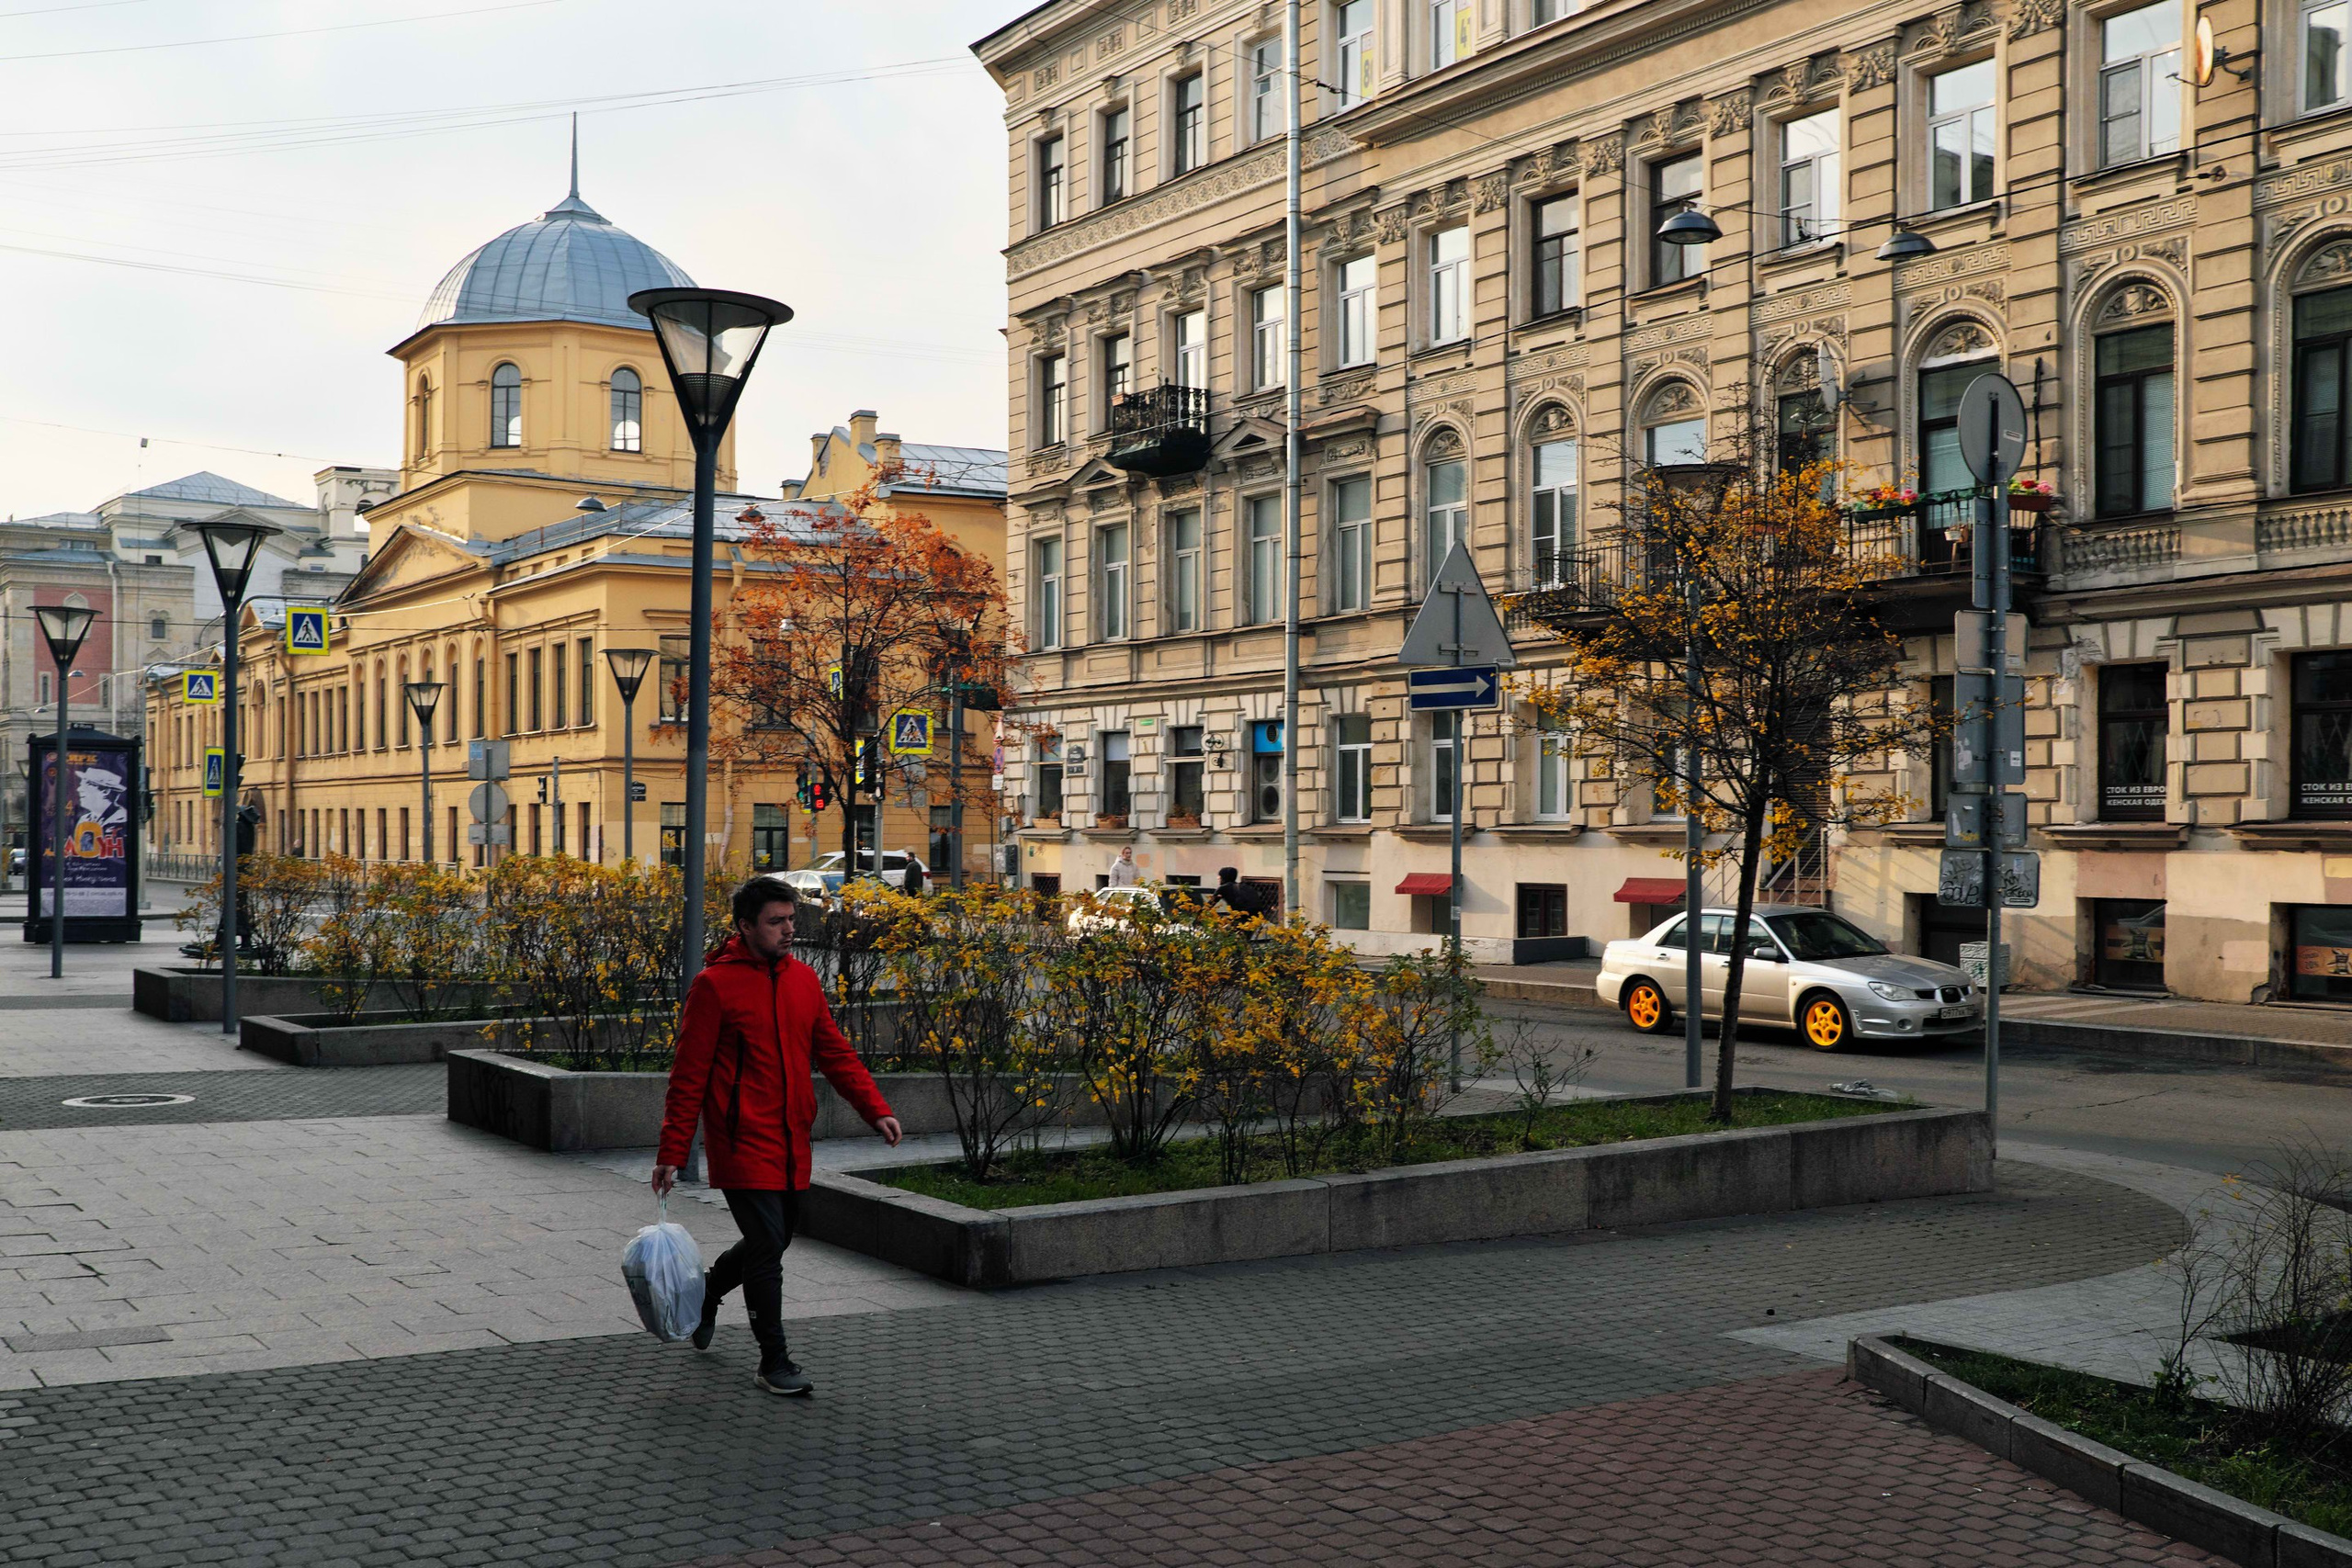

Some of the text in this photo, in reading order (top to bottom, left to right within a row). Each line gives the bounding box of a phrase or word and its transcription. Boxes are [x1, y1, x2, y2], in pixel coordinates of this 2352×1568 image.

[2129, 785, 2142, 794] ИЗ
[2143, 785, 2166, 794] ЕВРО
[2328, 783, 2343, 791] ИЗ
